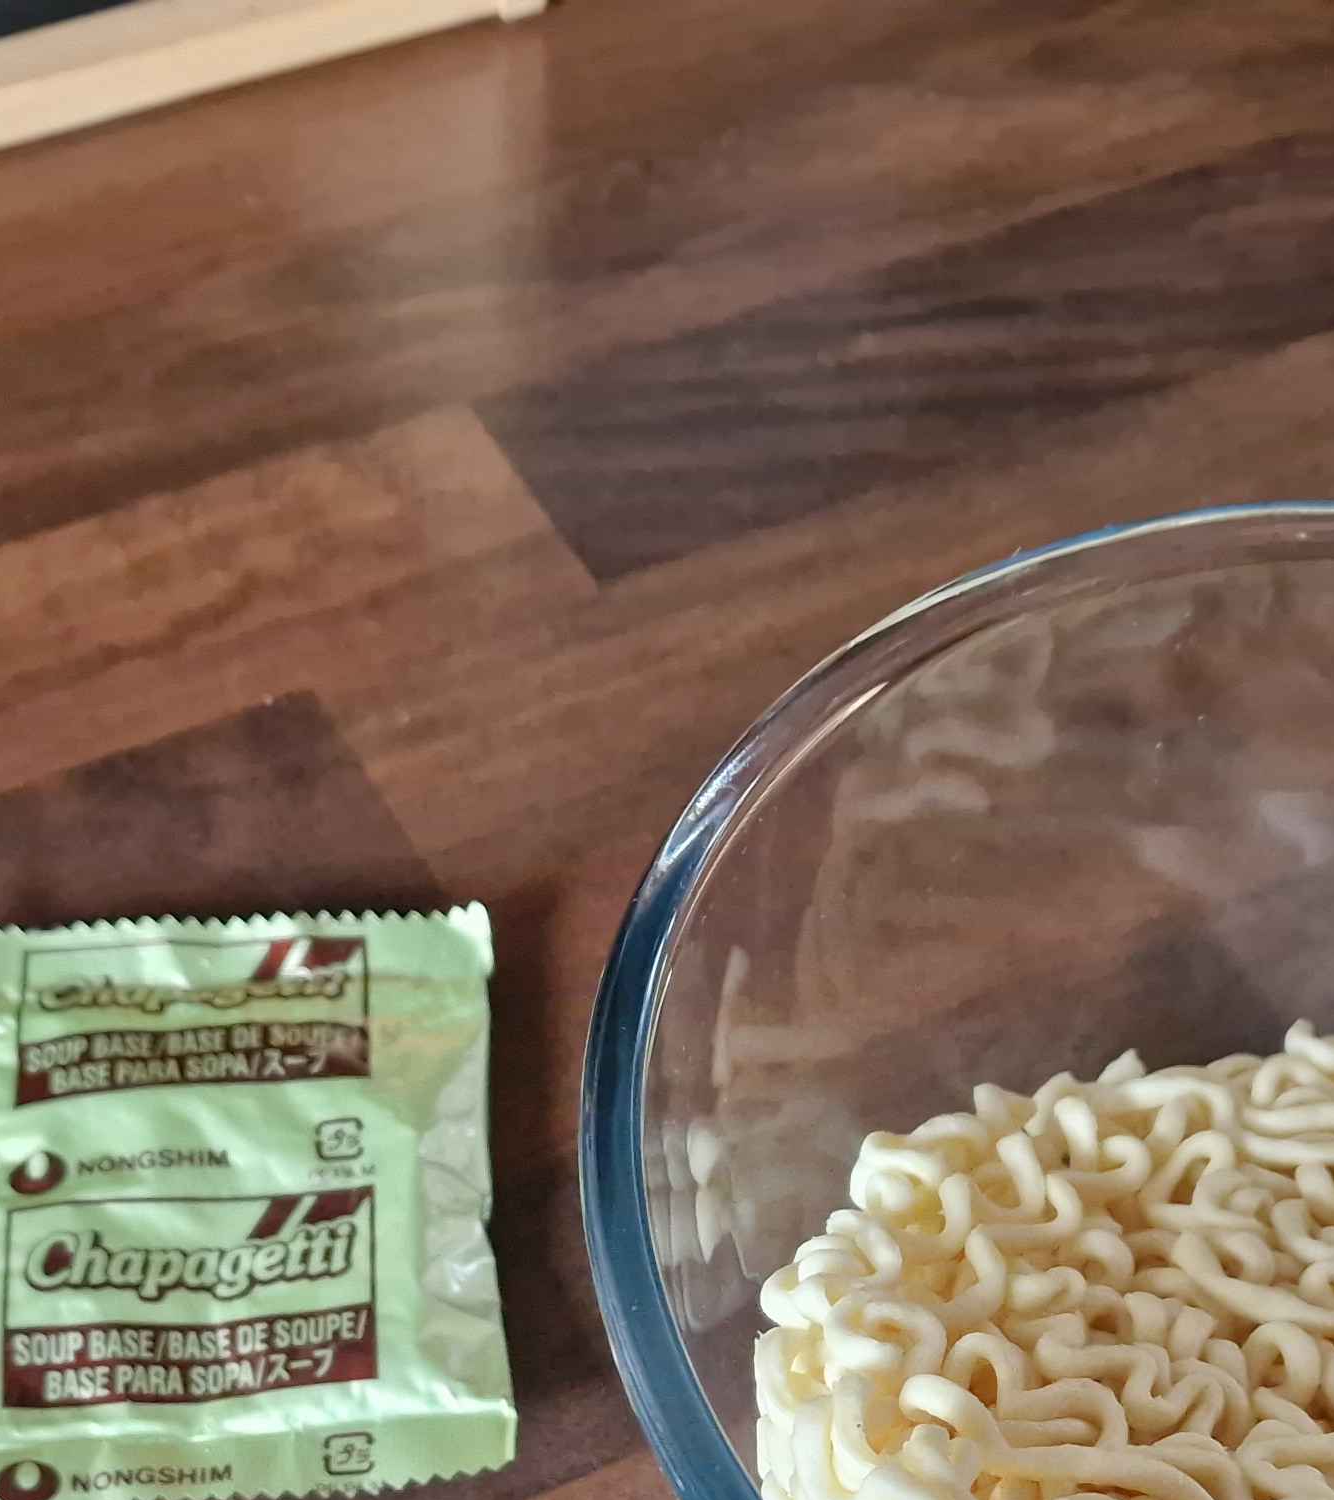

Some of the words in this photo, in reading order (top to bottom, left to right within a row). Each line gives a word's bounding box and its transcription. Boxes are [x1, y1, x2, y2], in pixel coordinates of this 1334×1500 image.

[26, 1037, 88, 1073] SOUP
[51, 1063, 110, 1095] BASE
[115, 1054, 181, 1086] PARA
[77, 1148, 231, 1177] NONGSHIM
[25, 1220, 356, 1302] Chapagetti
[12, 1330, 84, 1367] SOUP
[236, 1321, 269, 1355] DE
[274, 1308, 367, 1347] SOUPE/
[43, 1364, 110, 1402] BASE
[115, 1362, 185, 1397] PARA
[71, 1463, 234, 1495] NONGSHIM
